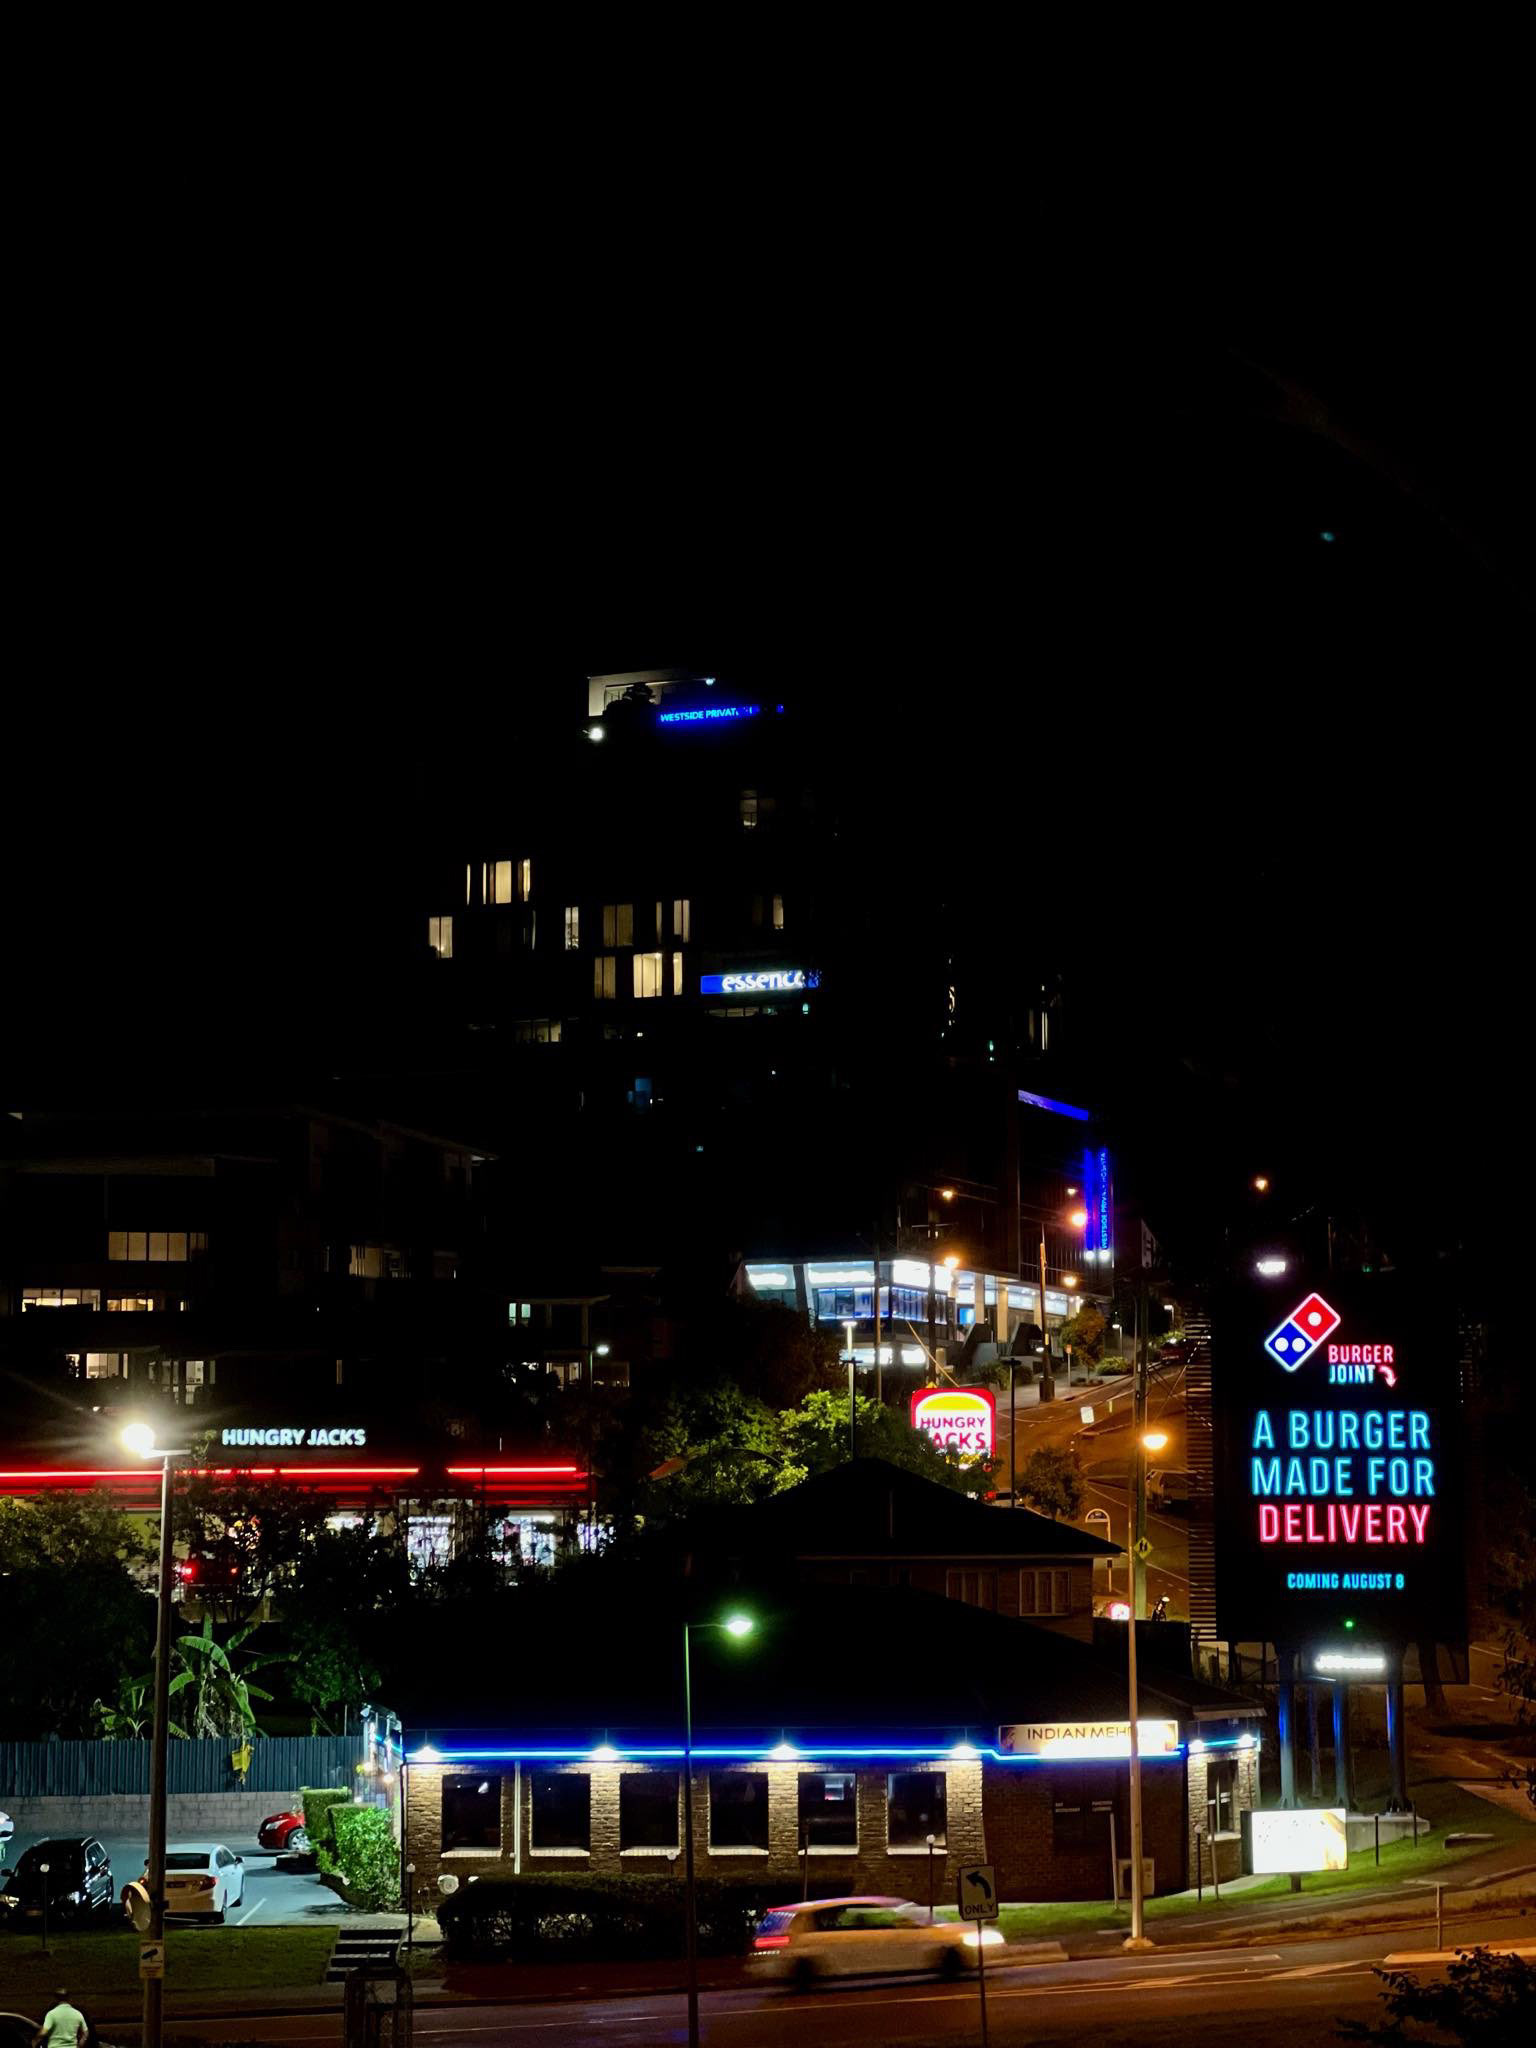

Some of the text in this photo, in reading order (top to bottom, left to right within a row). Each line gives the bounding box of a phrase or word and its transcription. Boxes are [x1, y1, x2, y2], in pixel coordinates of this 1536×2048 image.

[660, 711, 704, 722] WESTSIDE
[1328, 1344, 1394, 1363] BURGER
[1328, 1364, 1376, 1384] JOINT
[920, 1417, 986, 1430] HUNGRY
[1253, 1410, 1431, 1450] A BURGER
[222, 1428, 305, 1446] HUNGRY
[931, 1432, 986, 1450] ACKS
[1252, 1457, 1436, 1496] MADE FOR
[1259, 1504, 1431, 1544] DELIVERY
[1287, 1573, 1405, 1589] COMING AUGUST 8
[1027, 1727, 1086, 1740] INDIAN
[964, 1903, 995, 1916] ONLY
